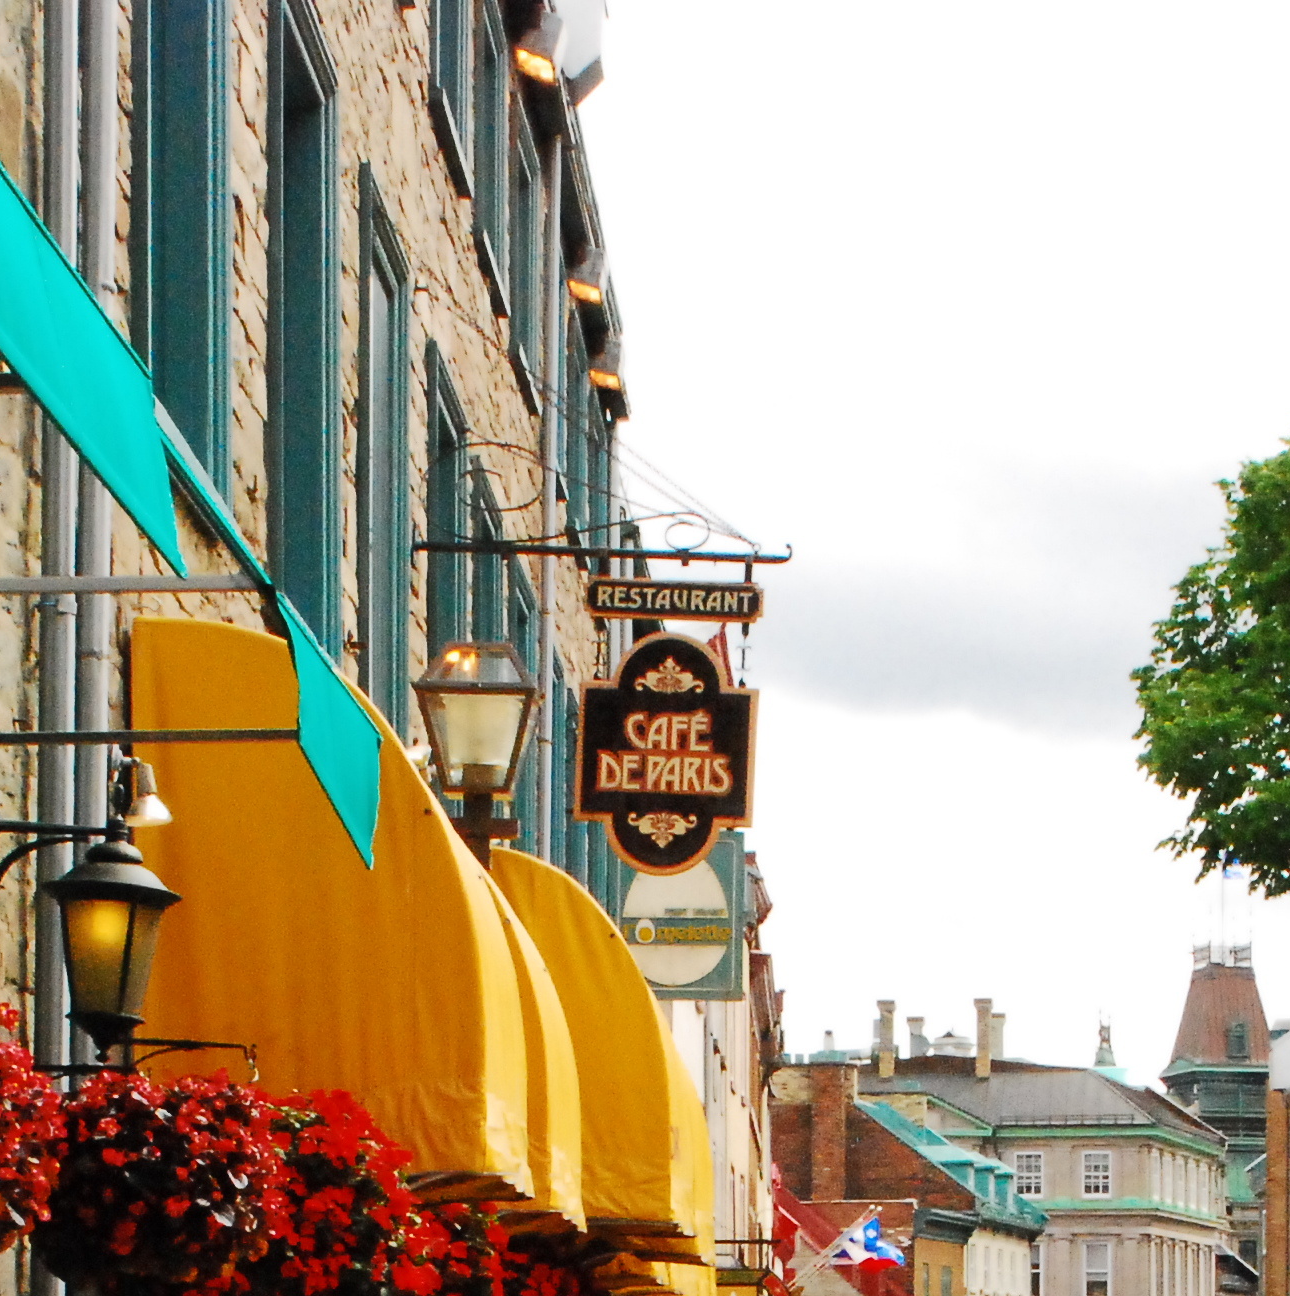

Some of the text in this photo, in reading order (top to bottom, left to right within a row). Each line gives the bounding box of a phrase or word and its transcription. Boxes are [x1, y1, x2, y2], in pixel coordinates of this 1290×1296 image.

[597, 585, 755, 613] RESTAURANT
[626, 711, 710, 752] CAFÉ
[600, 753, 730, 793] DE PARIS
